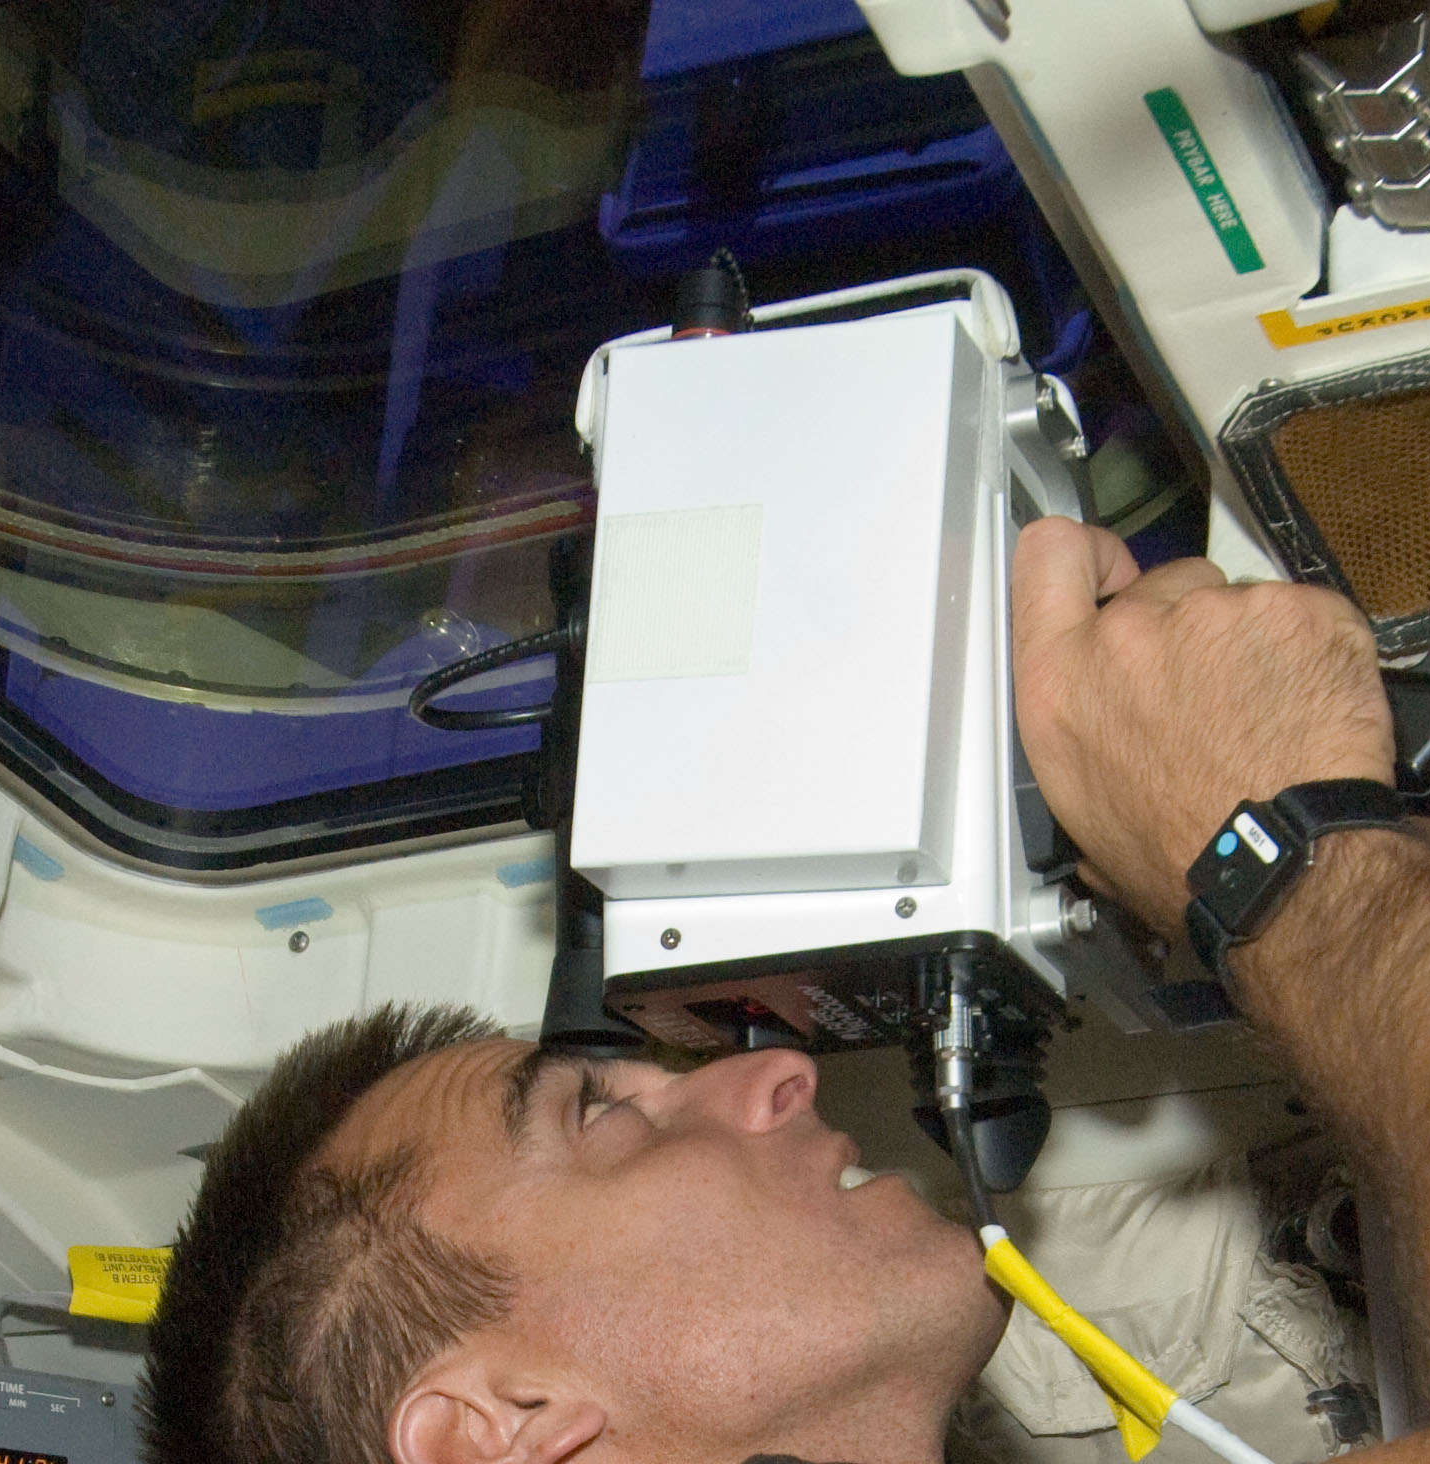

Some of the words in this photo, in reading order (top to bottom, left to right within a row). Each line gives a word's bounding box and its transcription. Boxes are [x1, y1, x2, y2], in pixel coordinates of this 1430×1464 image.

[1173, 129, 1208, 201] PRYBAR
[1206, 192, 1237, 231] HERE
[0, 1381, 26, 1395] TIME
[50, 1403, 66, 1413] SEC
